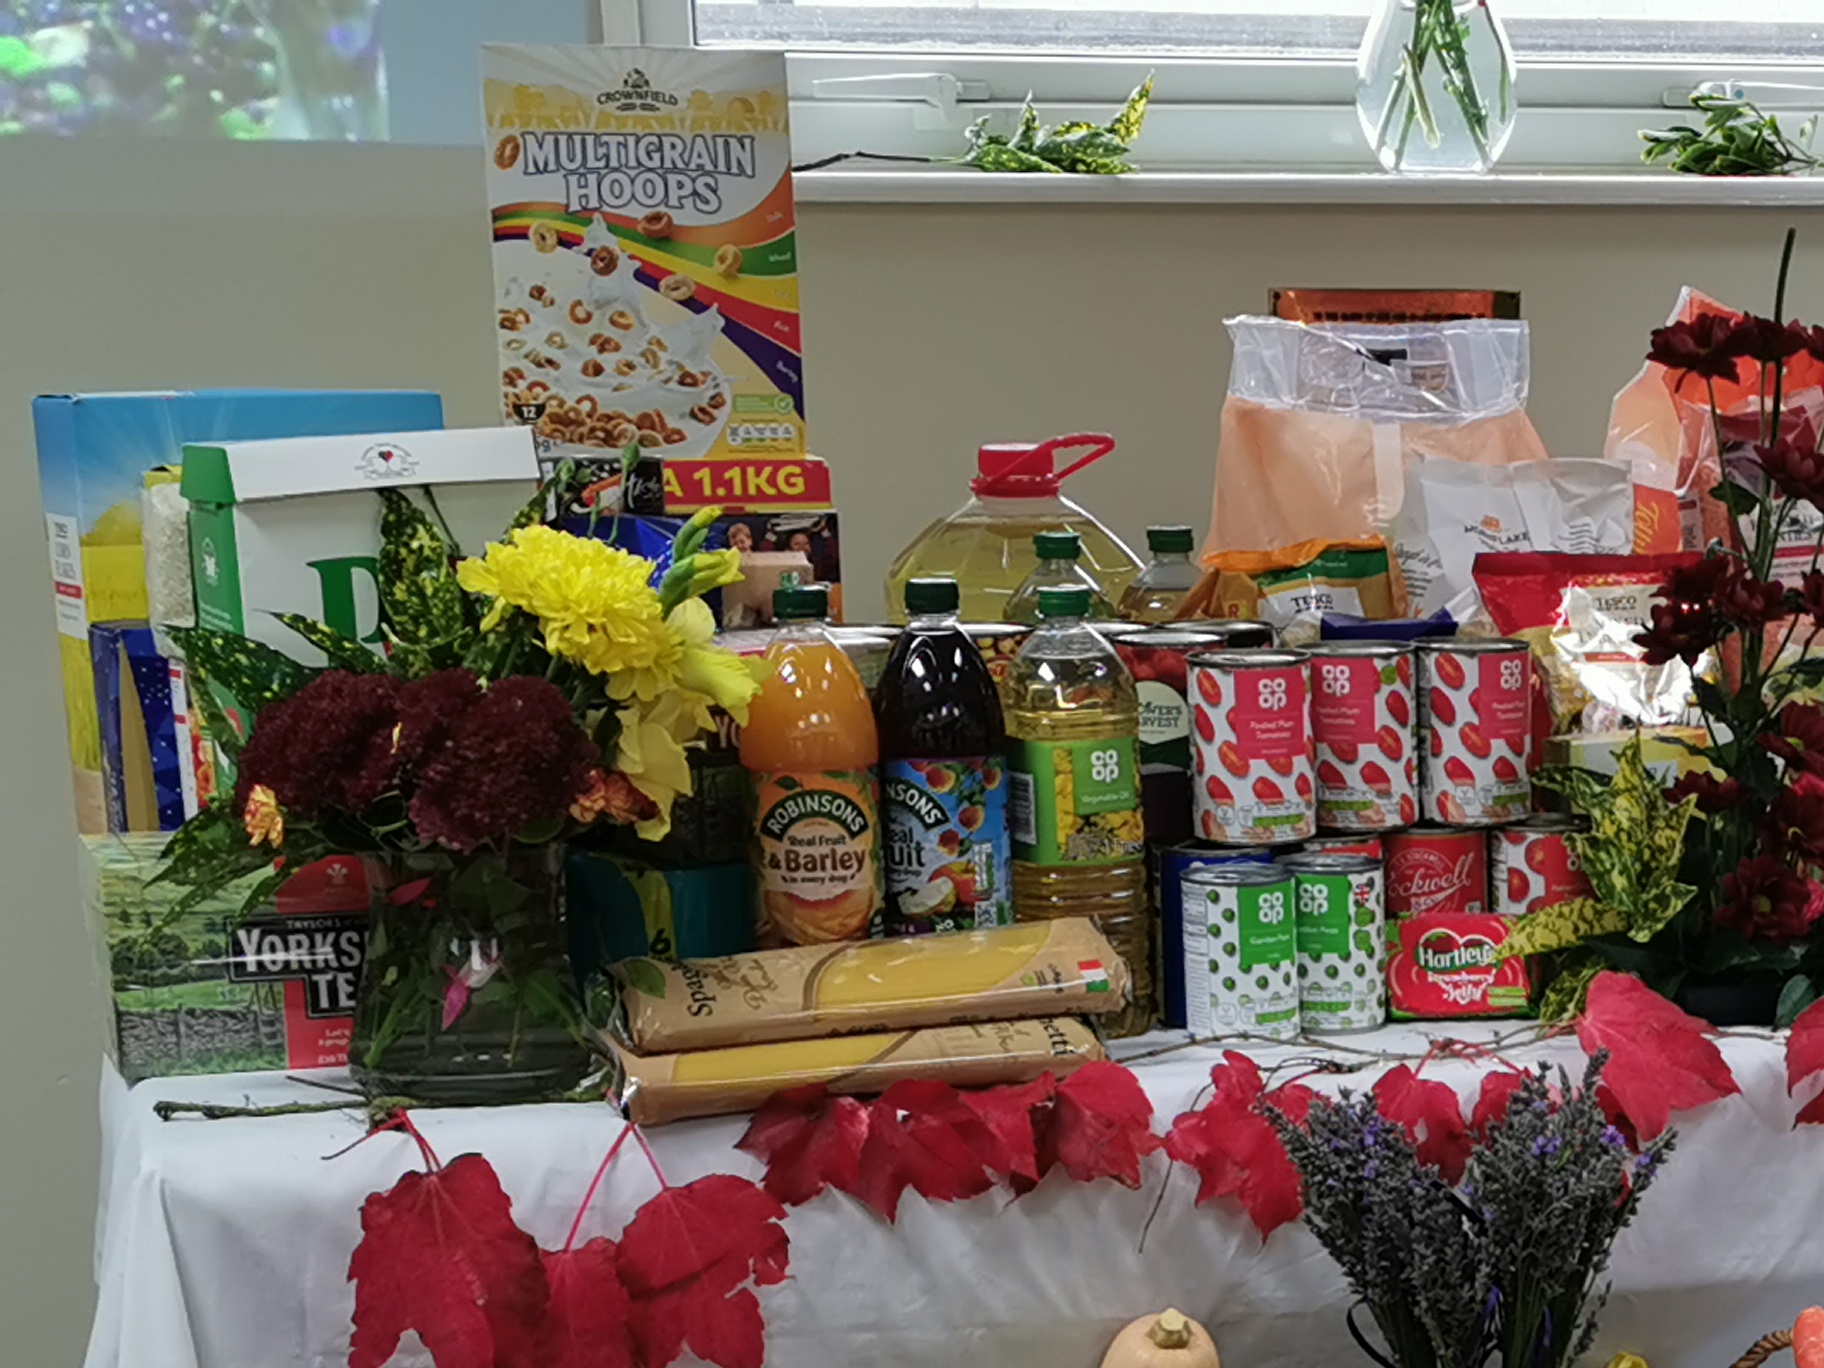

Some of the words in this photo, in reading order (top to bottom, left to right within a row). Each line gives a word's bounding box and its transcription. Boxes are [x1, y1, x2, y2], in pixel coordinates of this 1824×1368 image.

[597, 88, 679, 106] CROWNFIELD
[521, 132, 756, 178] MULTIGRAIN
[563, 171, 723, 214] HOOPS
[521, 405, 537, 420] 12
[692, 465, 806, 497] 1.1KG
[1140, 715, 1180, 729] RVEST
[766, 794, 865, 834] ROBINSONS
[885, 782, 946, 825] NSONS
[787, 836, 817, 847] Real
[818, 835, 847, 847] Fruit
[784, 848, 866, 874] Barley
[889, 842, 926, 868] uit
[237, 927, 368, 972] YORKS
[1442, 983, 1485, 1005] Jelly
